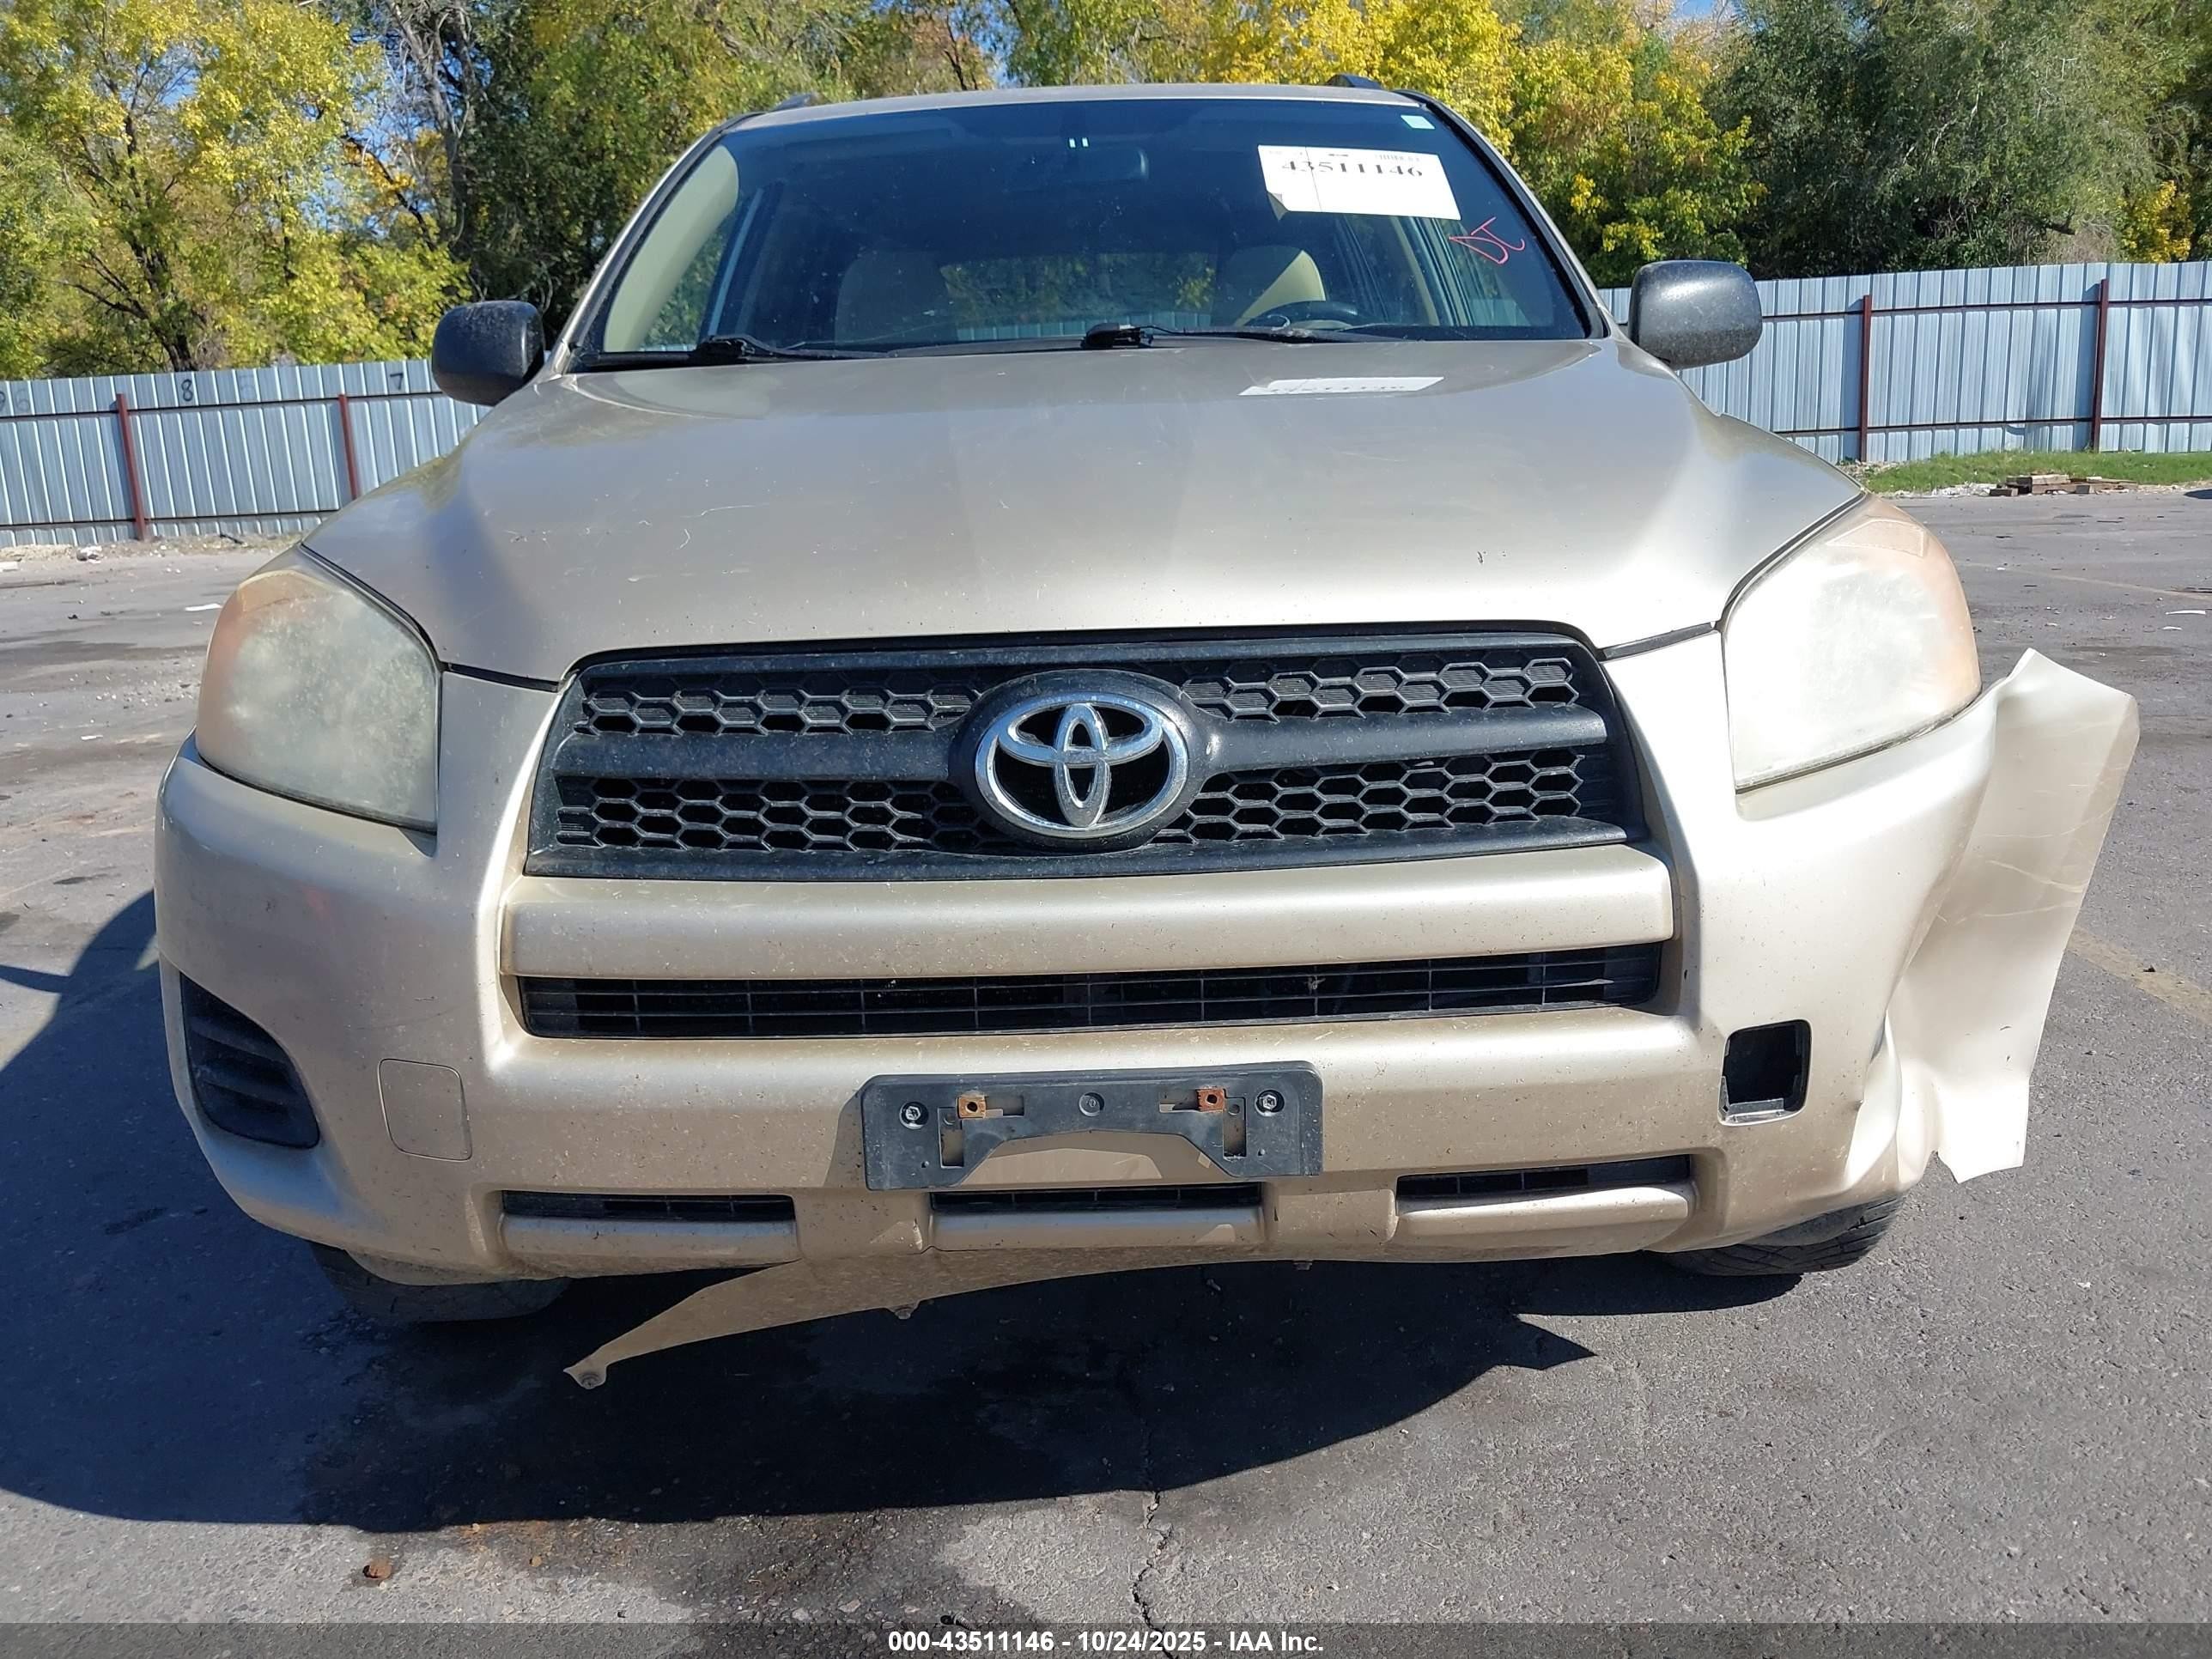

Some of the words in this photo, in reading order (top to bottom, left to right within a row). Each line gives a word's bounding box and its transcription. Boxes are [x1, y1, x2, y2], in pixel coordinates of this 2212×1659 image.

[1282, 160, 1423, 177] 43511146
[180, 378, 193, 402] 8
[390, 372, 404, 390] 7
